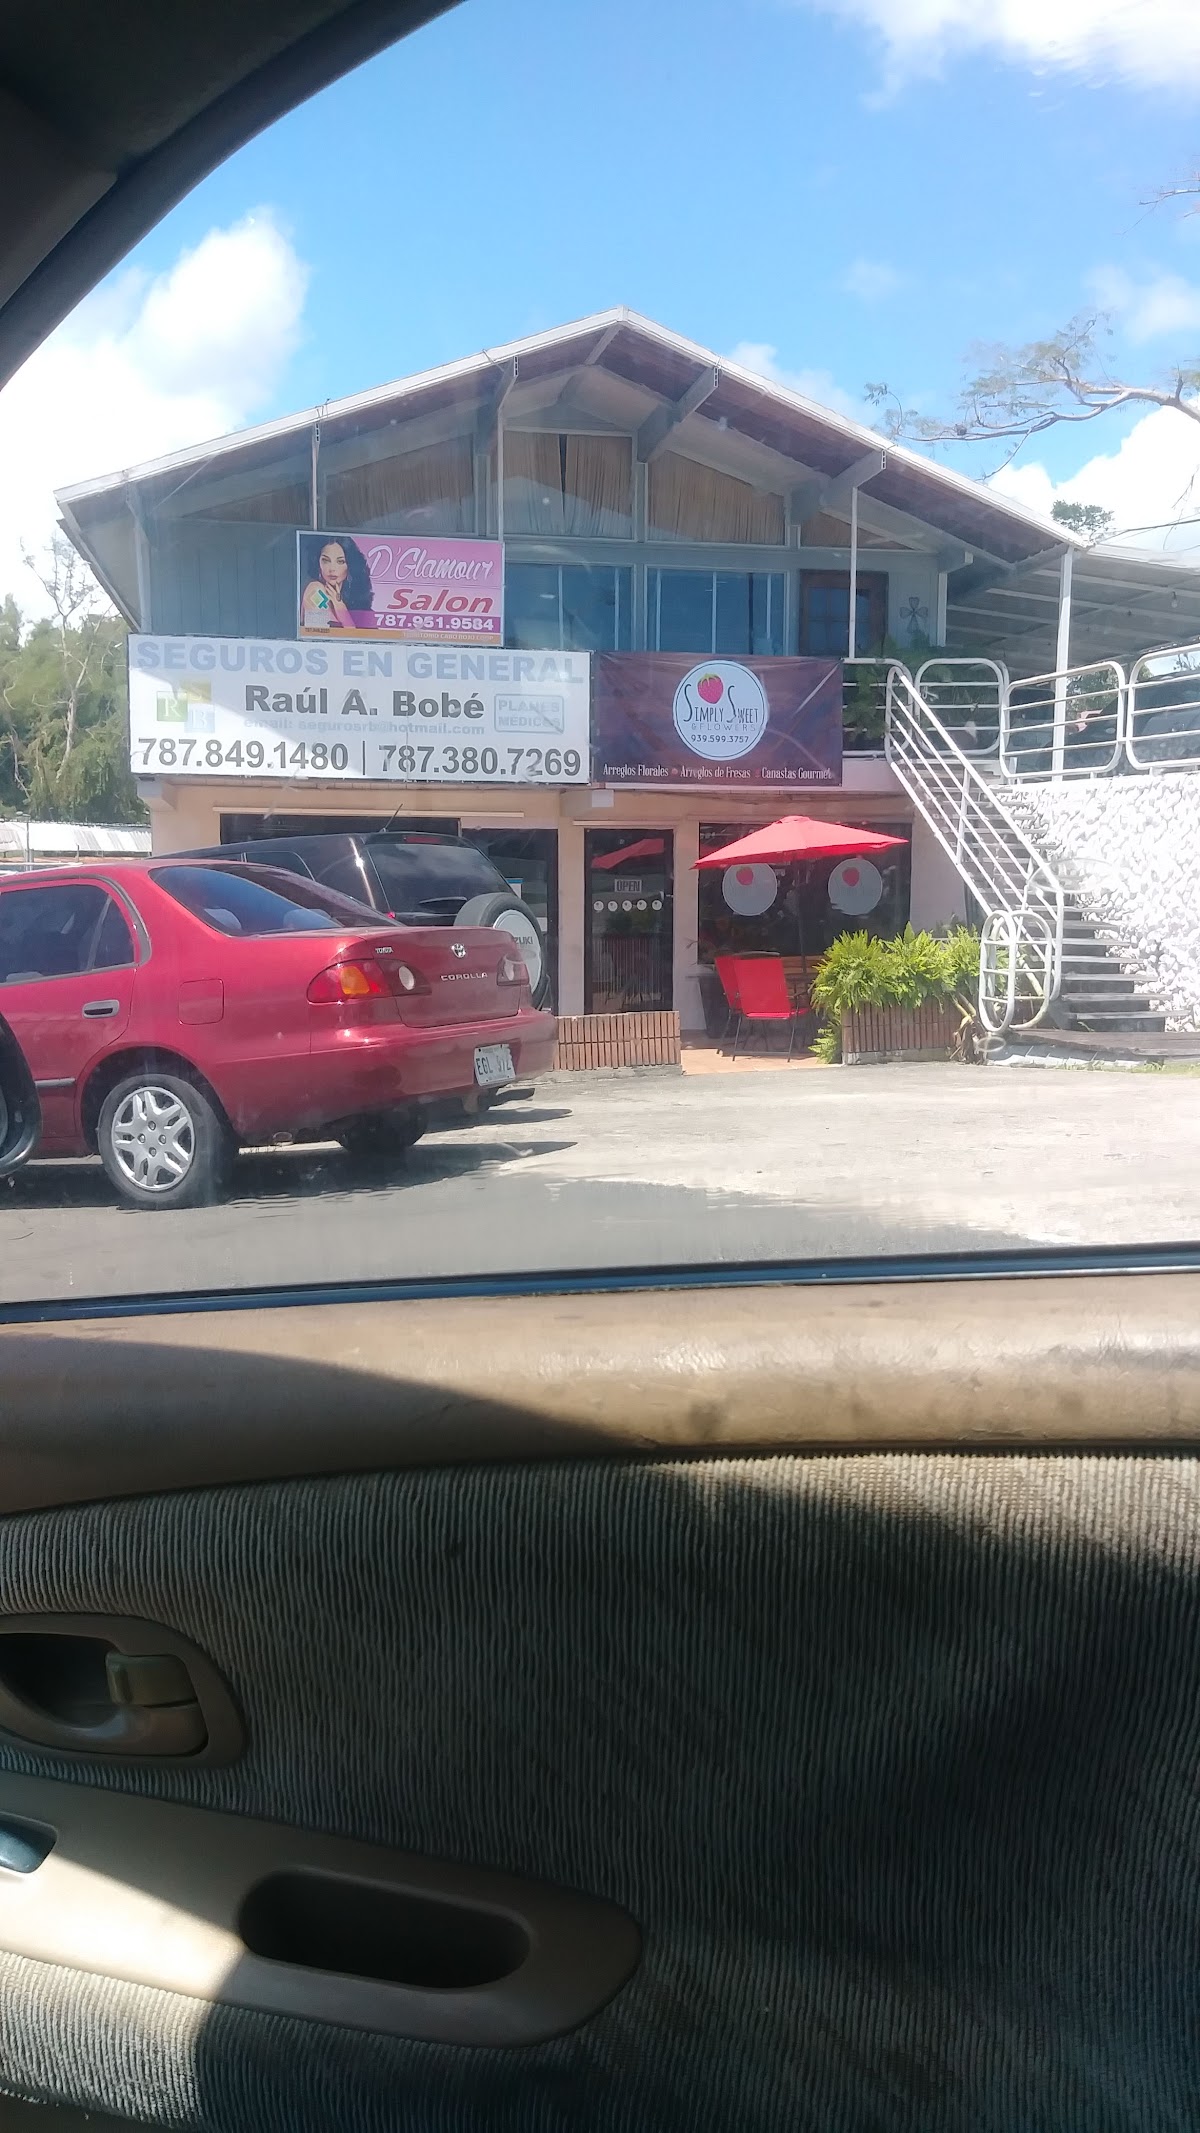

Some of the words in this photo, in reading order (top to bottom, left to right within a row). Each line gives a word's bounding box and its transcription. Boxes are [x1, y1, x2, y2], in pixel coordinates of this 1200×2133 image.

[367, 544, 494, 581] D'Glamour
[387, 588, 494, 614] Salon
[374, 613, 494, 631] 787.951.9584
[137, 641, 329, 675] SEGUROS
[343, 650, 393, 677] EN
[407, 652, 583, 684] GENERAL
[245, 684, 328, 715] Raúl
[341, 688, 378, 716] A.
[393, 690, 485, 719] Bobé
[499, 700, 560, 713] PLANES
[683, 683, 724, 723] SIMPLY
[690, 734, 749, 743] 939.599.3757
[138, 738, 349, 771] 787.849.1480
[378, 744, 581, 777] 787.380.7269
[602, 763, 636, 778] Arreglos
[638, 764, 669, 777] Florales
[680, 765, 713, 780] Arreglos
[714, 766, 725, 777] de
[725, 766, 751, 778] Fresas
[761, 767, 797, 779] Canastas
[798, 767, 833, 780] Gourmet
[617, 880, 640, 892] OPEN
[514, 936, 533, 945] ZUKI
[440, 972, 488, 981] COROLLA
